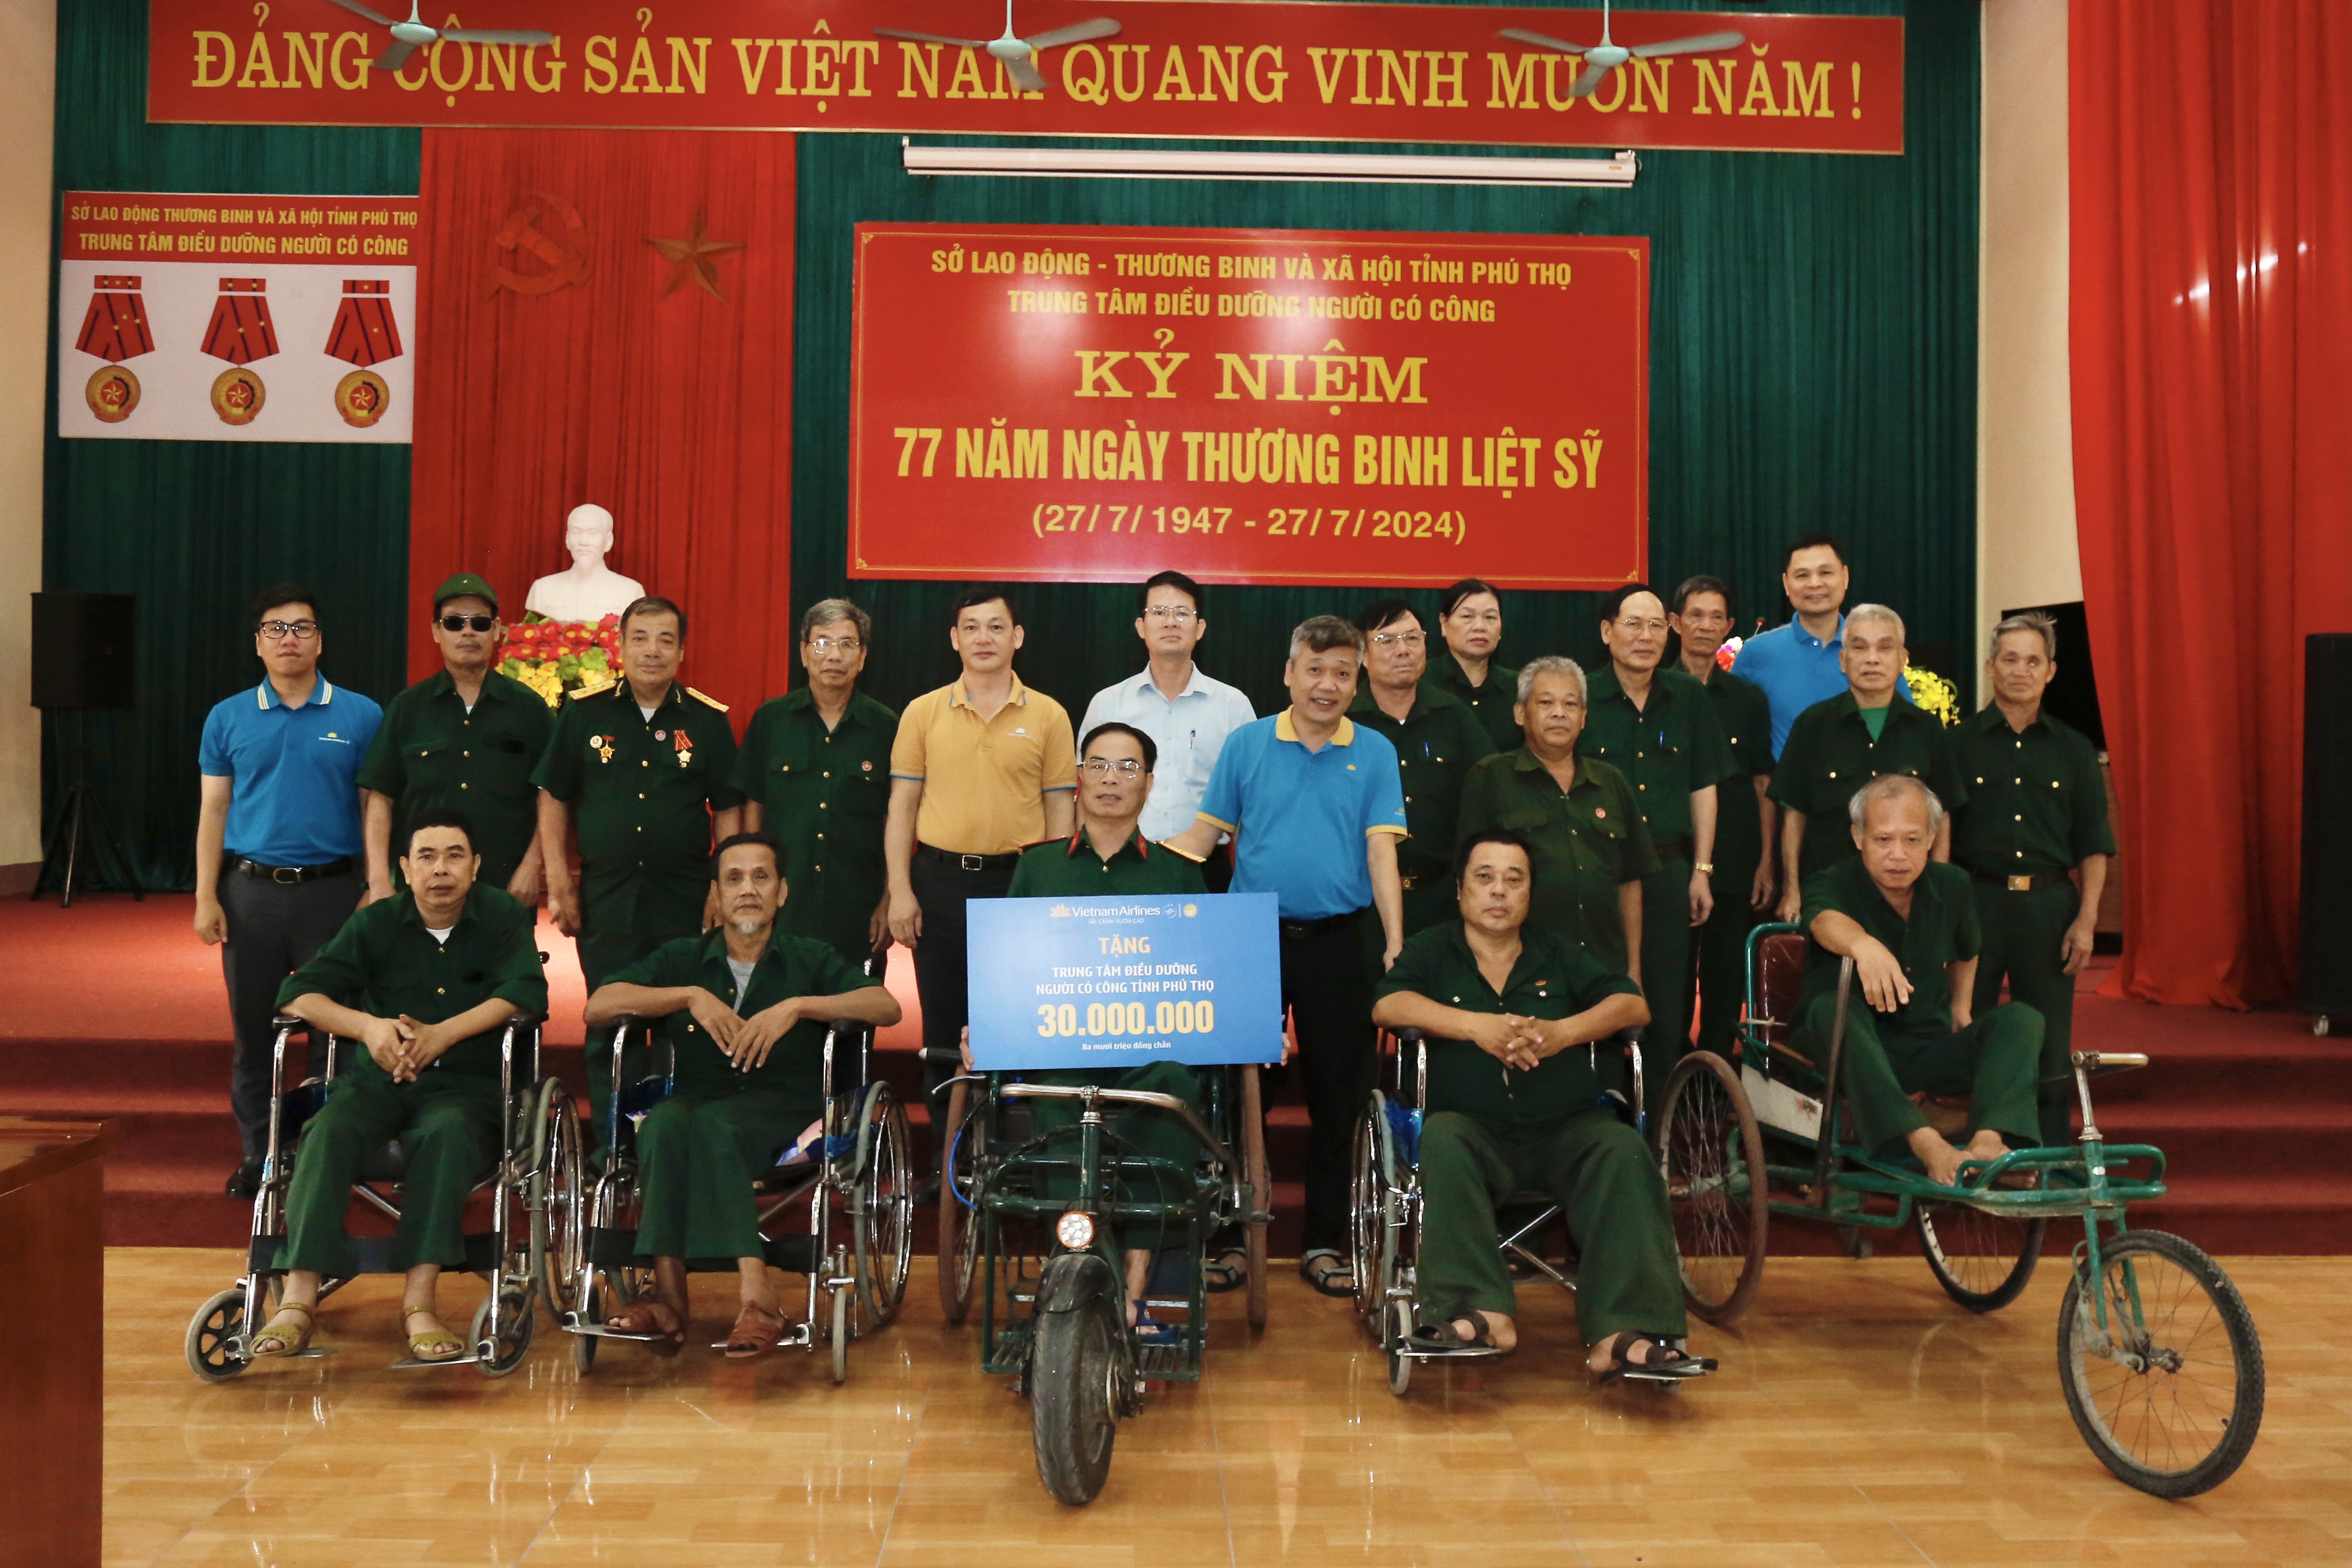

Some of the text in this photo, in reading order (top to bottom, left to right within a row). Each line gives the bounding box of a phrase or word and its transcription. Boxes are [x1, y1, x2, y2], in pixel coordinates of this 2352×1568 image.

[192, 2, 373, 90] ĐẢNG
[585, 8, 712, 94] SẢN
[731, 19, 879, 113] VIỆT
[1063, 44, 1288, 105] QUANG
[1307, 47, 1469, 107] VINH
[1692, 43, 1834, 117] NĂM
[72, 201, 417, 229] SỞ LAO ĐỘNG THƯƠNG BINH VÀ XÃ HỘI TỈNH PHÚ THỌ
[80, 234, 133, 250] TRUNG
[139, 231, 173, 251] TÂM
[221, 232, 276, 253] DƯỠNG
[281, 233, 331, 254] NGƯỜI
[337, 235, 358, 254] CÓ
[364, 235, 407, 255] CÔNG
[931, 243, 964, 272] SỞ
[971, 251, 1015, 274] LAO
[1022, 248, 1090, 279] ĐỘNG
[1114, 253, 1210, 277] THƯƠNG
[1218, 256, 1277, 278] BINH
[1285, 253, 1310, 279] VÀ
[1323, 254, 1354, 281] XÃ
[1362, 255, 1401, 286] HỘI
[1409, 253, 1463, 283] TỈNH
[1472, 258, 1519, 284] PHÚ
[1527, 263, 1571, 290] THỌ
[1007, 287, 1495, 322] TRUNG TÂM ĐIỀU DƯỠNG NGƯỜI CÓ CÔNG
[1074, 328, 1428, 415] KỶ NIỆM
[894, 417, 1603, 498] 77 NĂM NGÀY THƯƠNG BINH LIỆT SỸ
[1072, 906, 1160, 916] Vietnam Airlines
[1099, 934, 1150, 957] TẶNG
[1052, 963, 1197, 977] TRUNG TÂM ĐIỀU DƯỠNG
[1037, 978, 1214, 994] NGƯỜI CÓ CÔNG TỈNH PHÚ THỌ
[1038, 1000, 1214, 1037] 30.000.000
